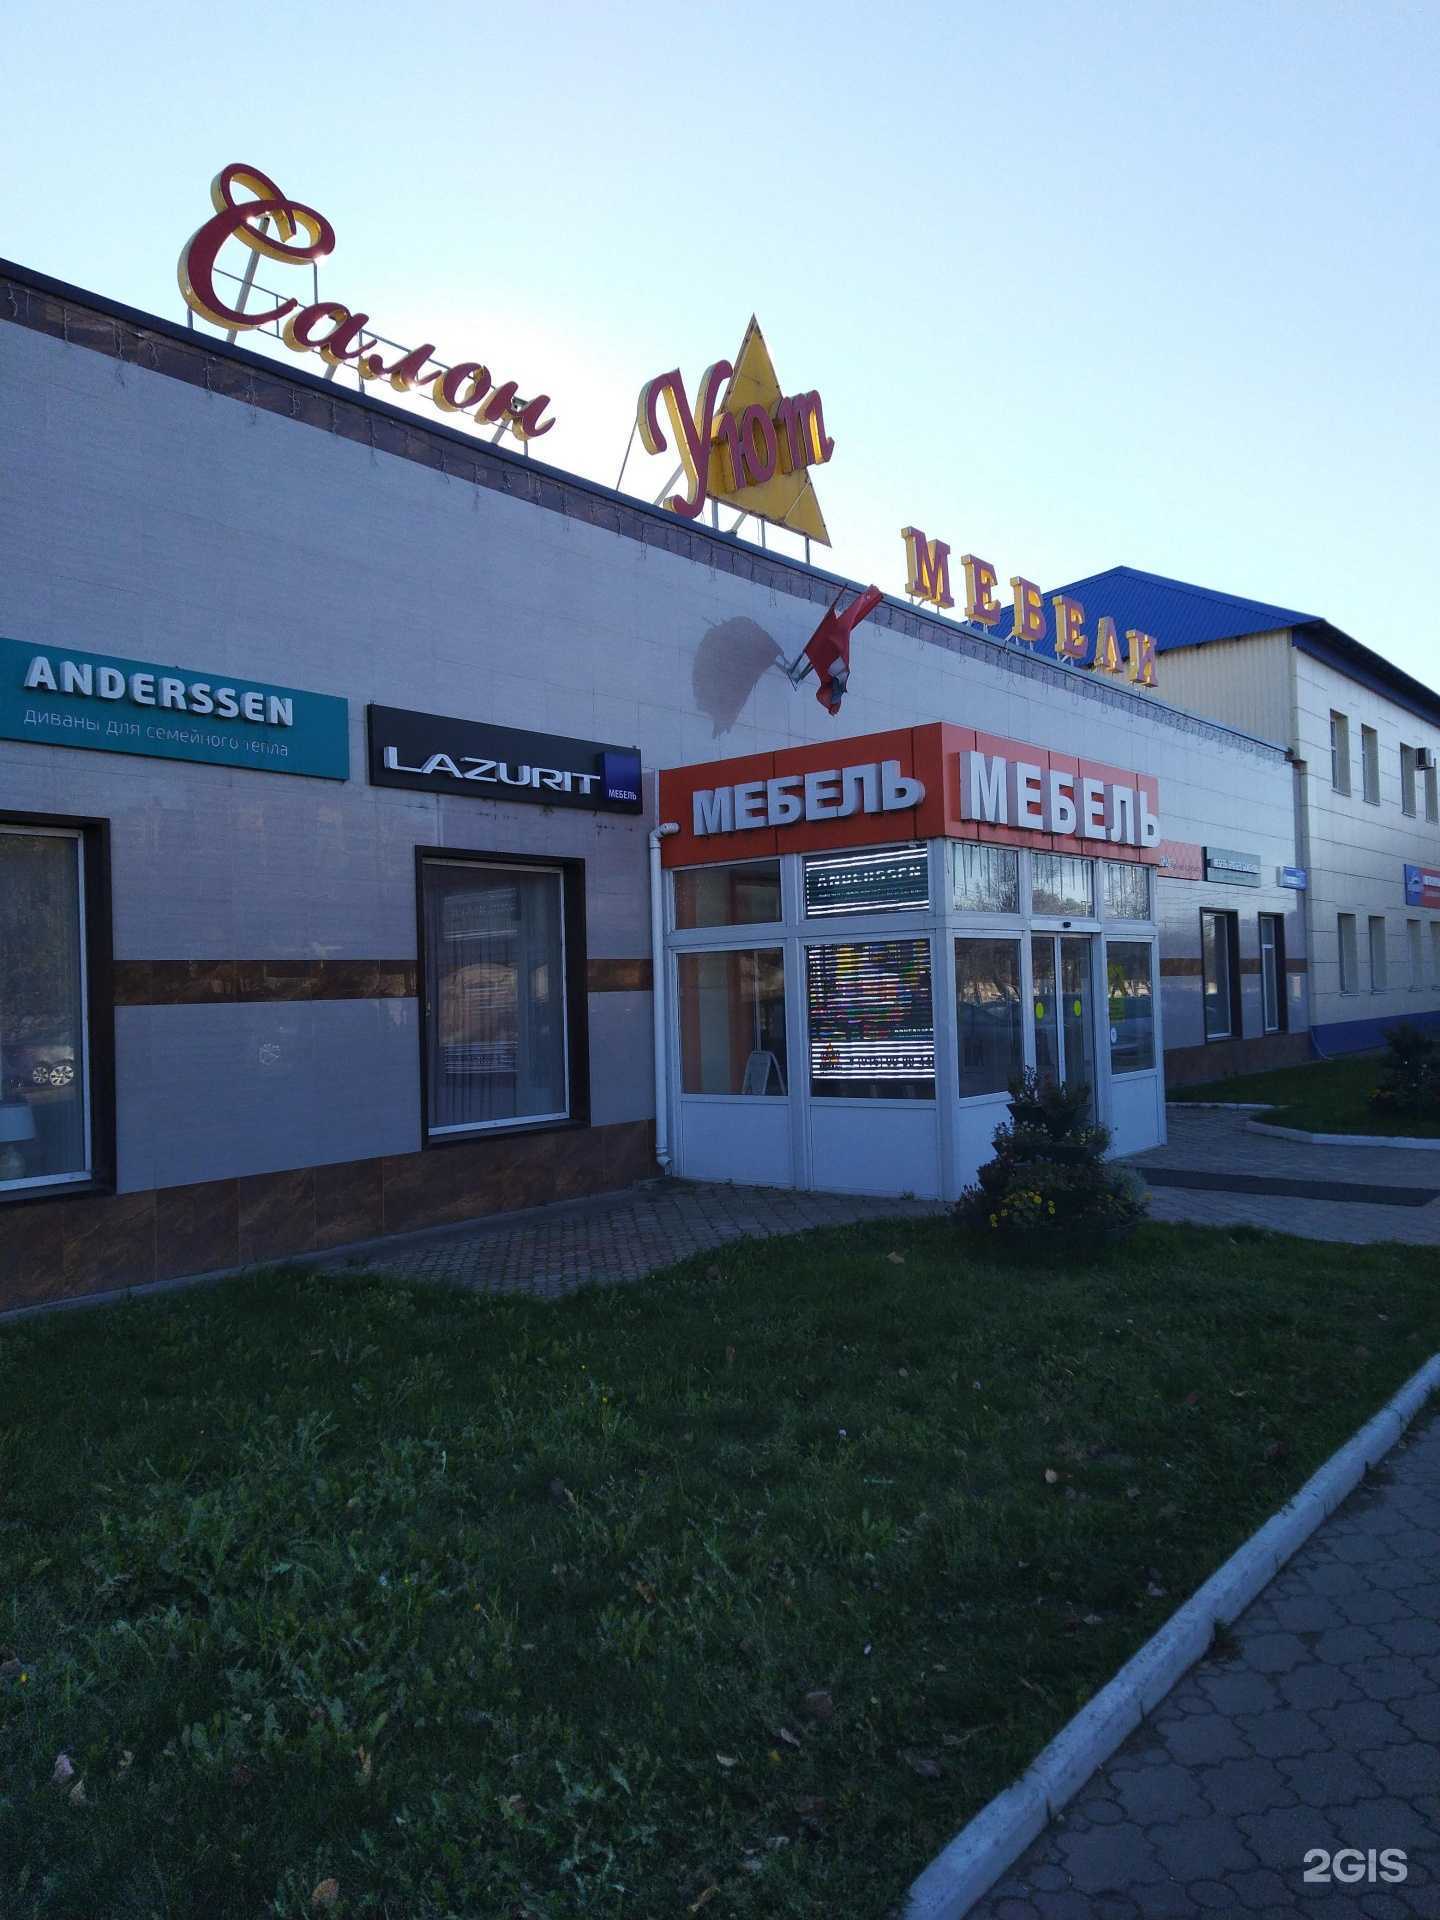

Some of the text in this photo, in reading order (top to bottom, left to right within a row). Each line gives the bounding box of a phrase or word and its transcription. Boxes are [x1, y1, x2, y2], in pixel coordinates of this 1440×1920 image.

[176, 162, 1159, 688] Салон Уют МЕБЕЛИ
[24, 656, 294, 727] ANDERSSEN
[146, 727, 240, 750] семейного
[384, 746, 600, 794] LAZURIT
[608, 788, 637, 800] МЕБЕЛЬ
[692, 760, 926, 836] МЕБЕЛЬ
[959, 750, 1161, 848] МЕБЕЛЬ
